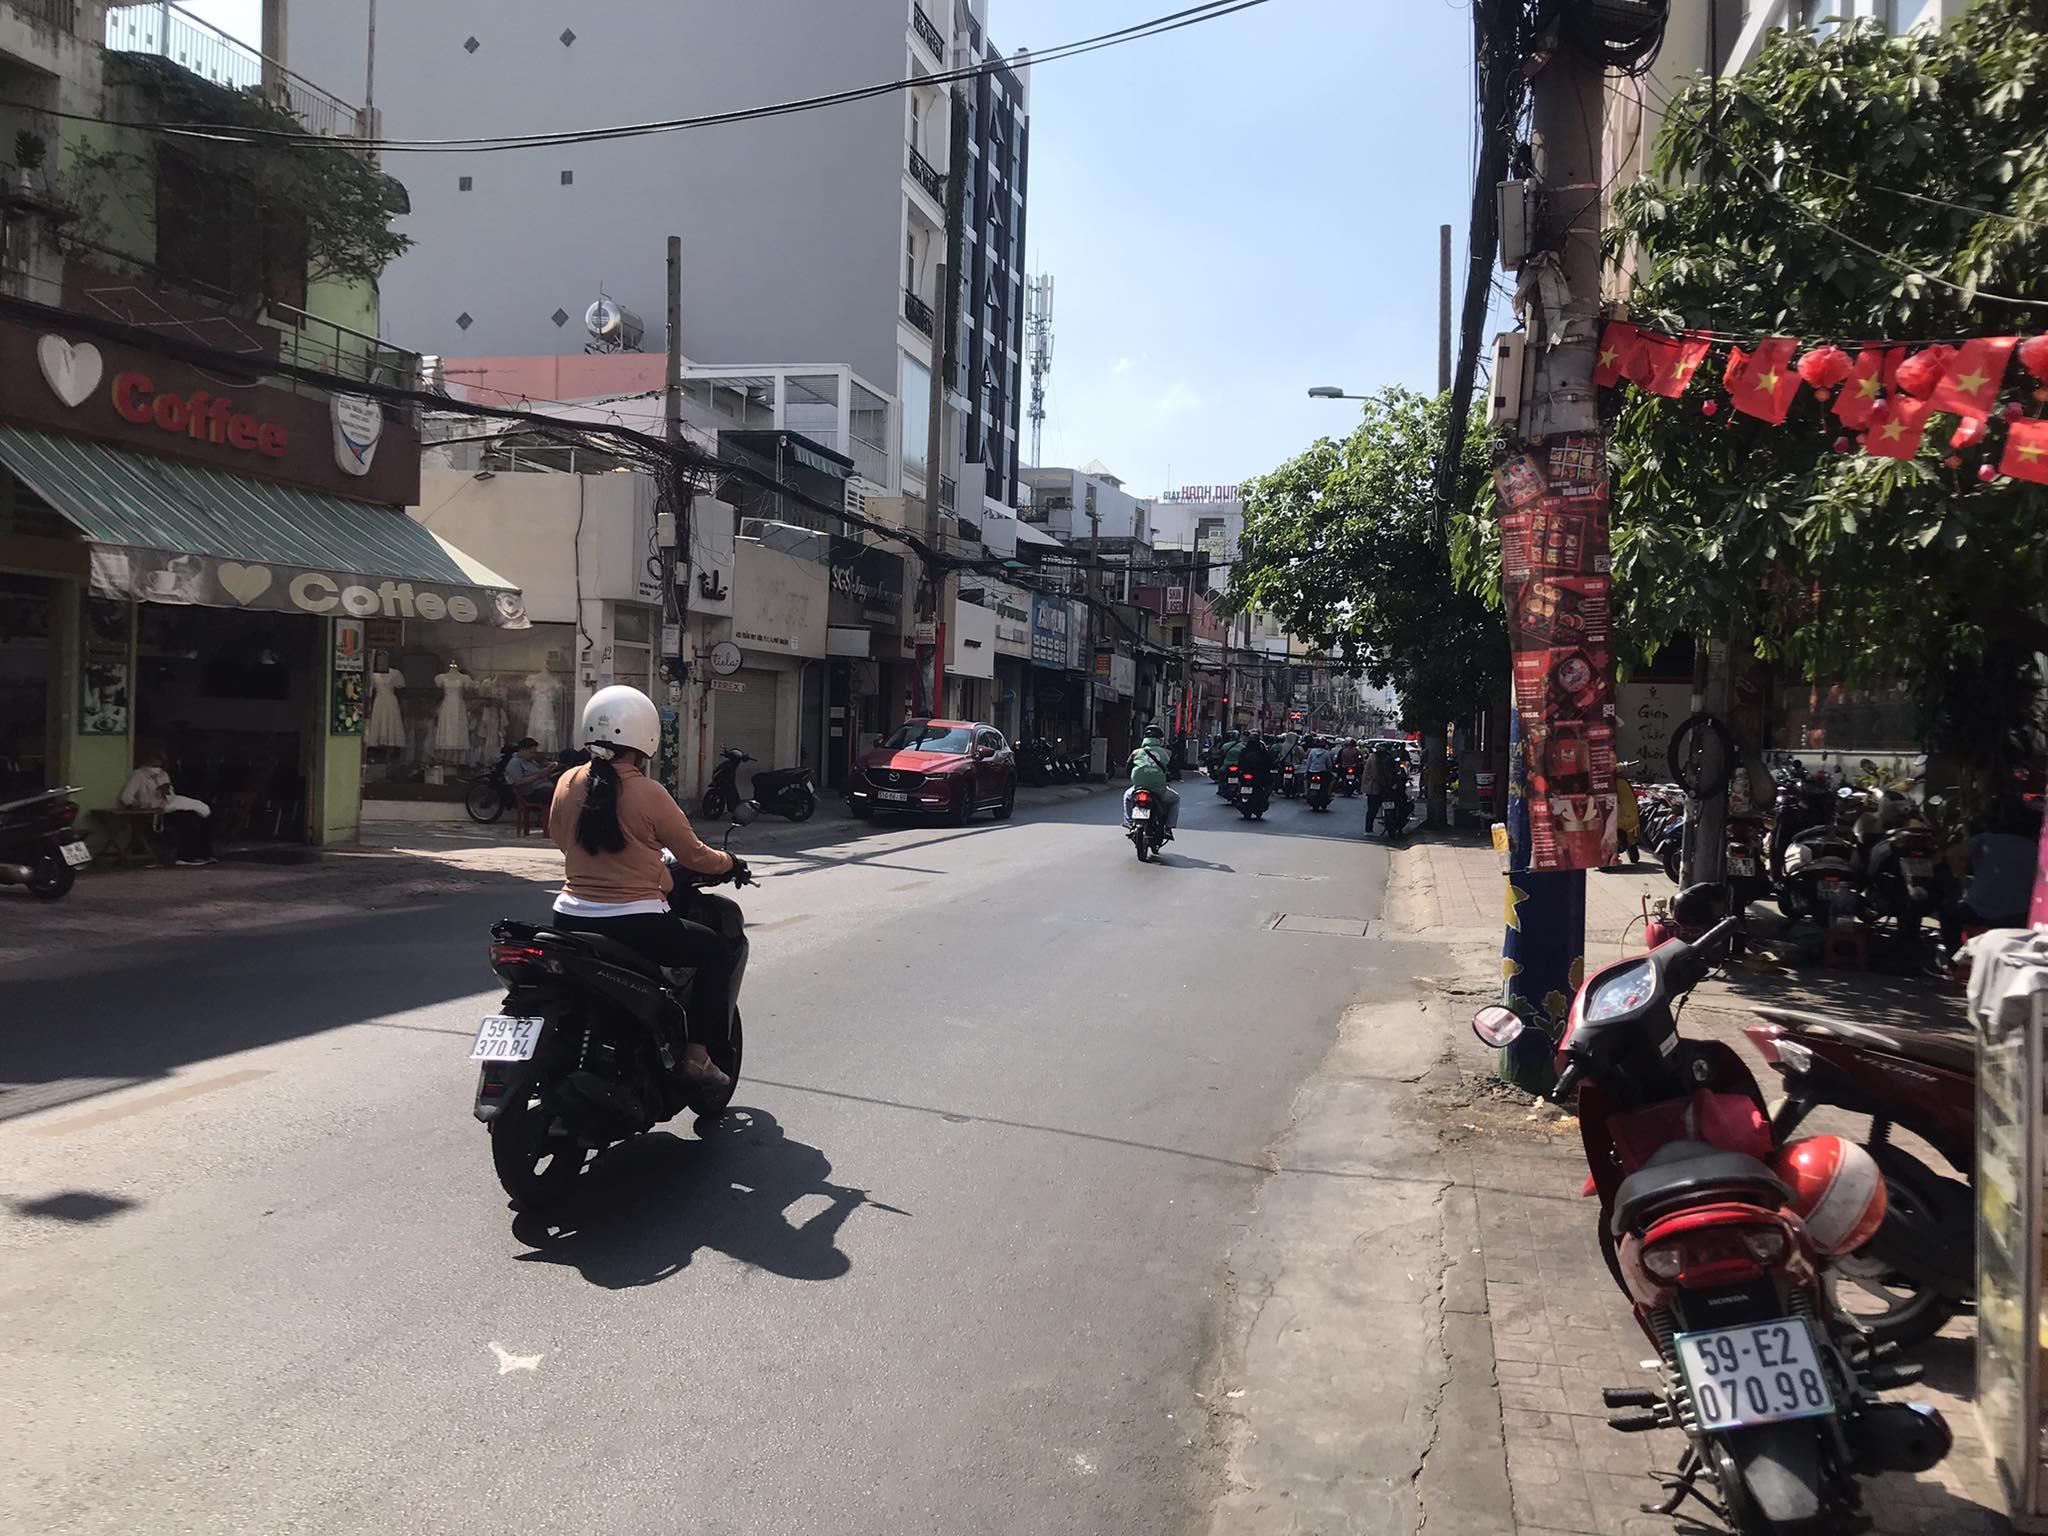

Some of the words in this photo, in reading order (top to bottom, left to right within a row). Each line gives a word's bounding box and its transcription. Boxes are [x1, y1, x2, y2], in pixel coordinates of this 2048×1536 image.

[112, 371, 289, 458] Coffee
[288, 572, 479, 623] Coffee
[475, 1039, 530, 1057] 370.84
[487, 1020, 534, 1038] 59-F2
[1708, 1294, 1750, 1306] HONDA
[1695, 1326, 1799, 1376] 59-E2
[1698, 1368, 1825, 1423] 070.98
